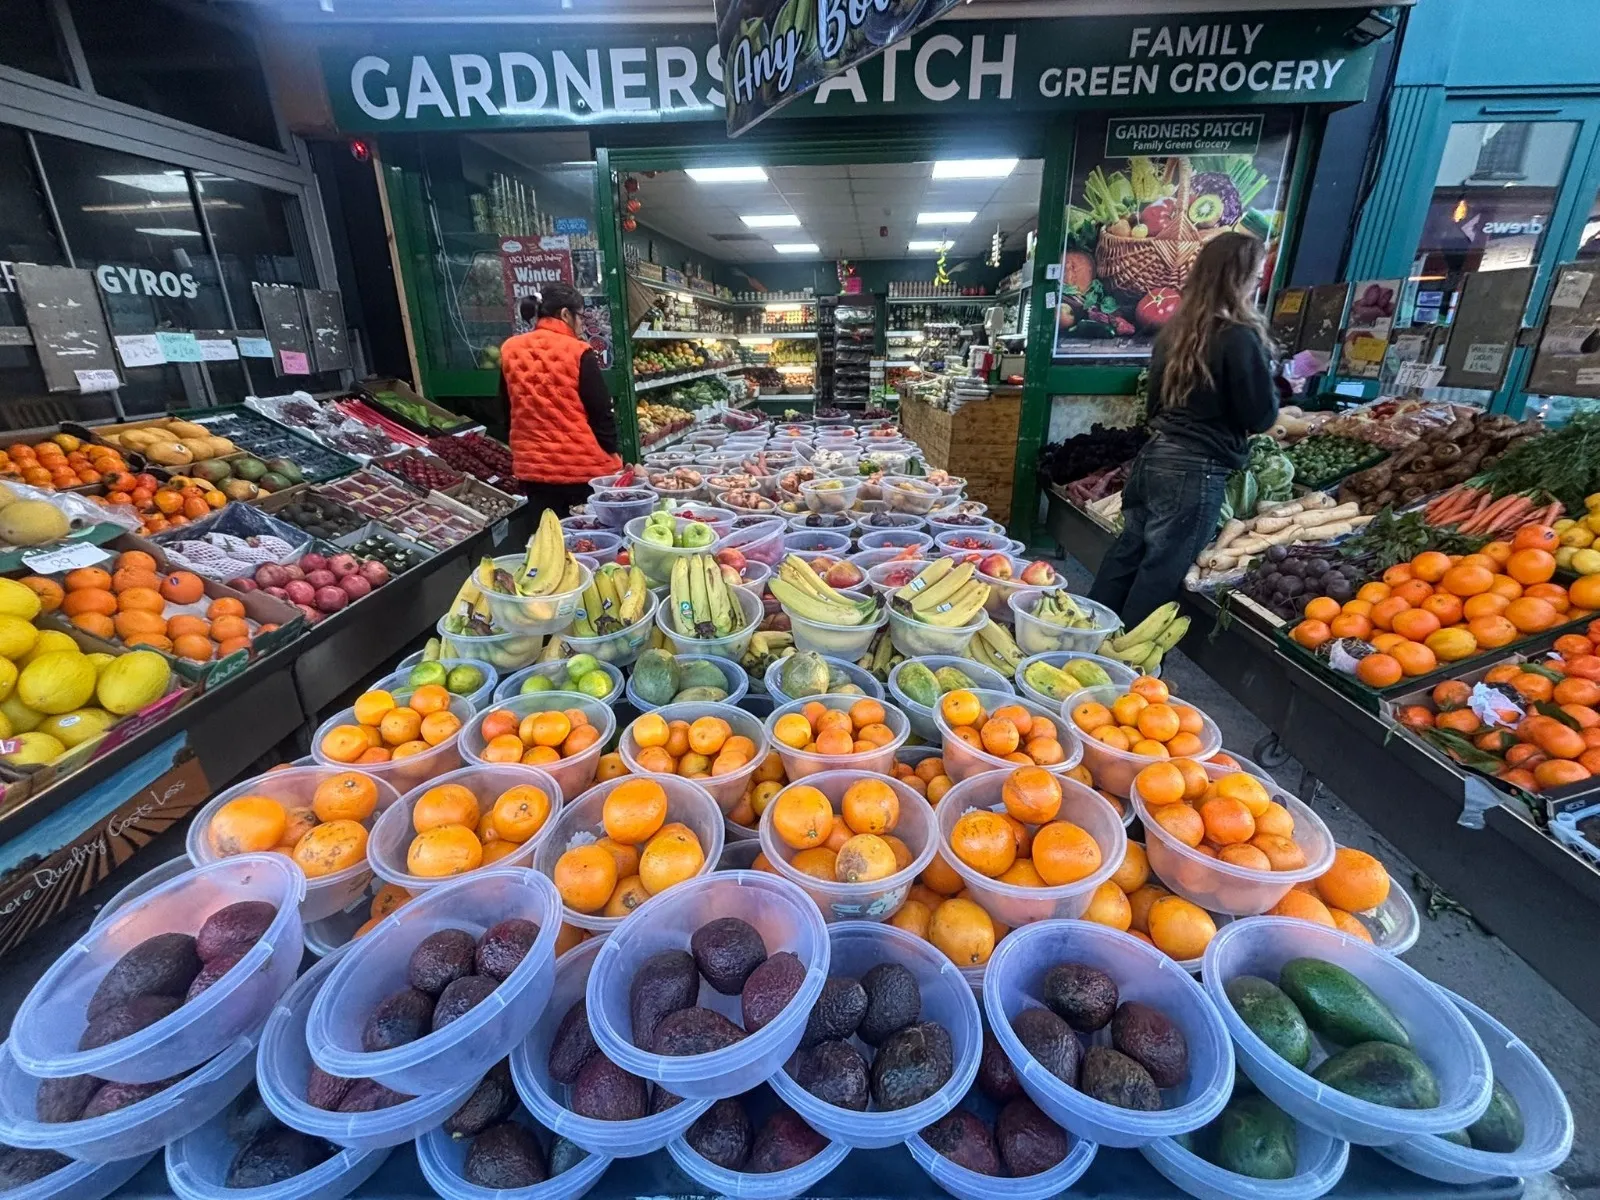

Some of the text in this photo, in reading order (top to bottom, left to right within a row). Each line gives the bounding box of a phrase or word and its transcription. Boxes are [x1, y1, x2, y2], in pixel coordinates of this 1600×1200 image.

[1128, 24, 1264, 58] FAMILY
[733, 29, 803, 104] Any
[813, 33, 1017, 104] ATCH
[1039, 58, 1345, 98] GREEN GROCERY
[1115, 121, 1254, 140] GARDNERS PATCH
[1133, 139, 1231, 152] Family Green Grocery
[97, 265, 198, 299] GYROS
[514, 265, 561, 283] Winter
[33, 838, 107, 889] Quality
[108, 804, 153, 837] Costs
[150, 780, 185, 805] Less
